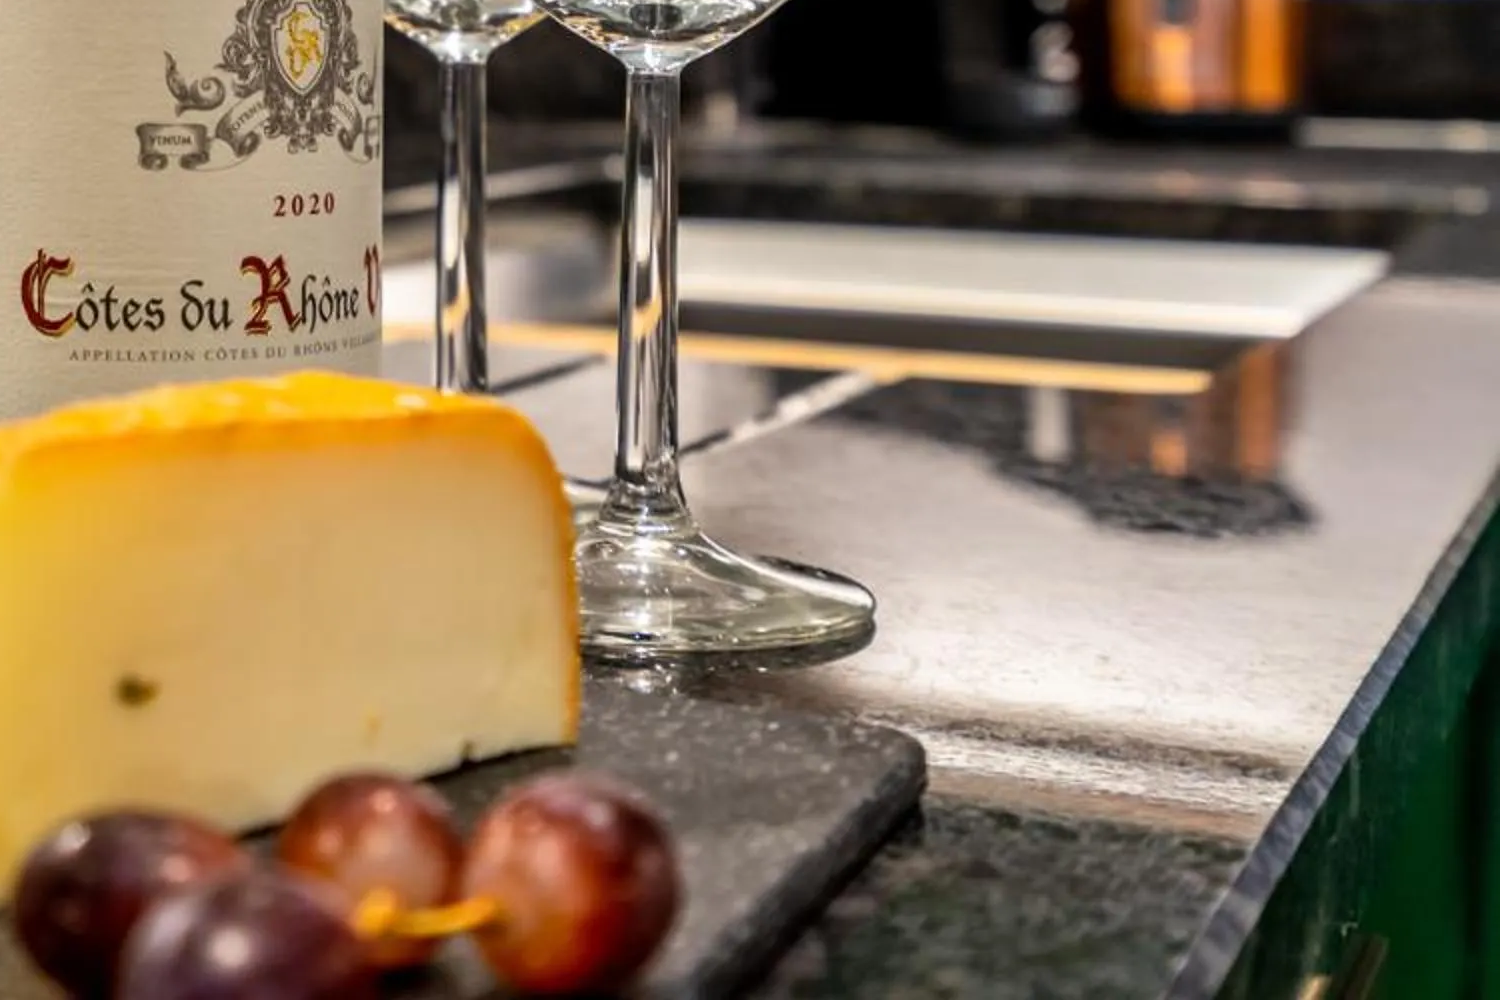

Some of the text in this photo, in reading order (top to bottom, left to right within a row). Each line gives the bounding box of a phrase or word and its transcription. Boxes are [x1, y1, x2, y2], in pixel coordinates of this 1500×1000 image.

[273, 193, 335, 217] 2020
[21, 248, 165, 336] Côtes
[180, 279, 233, 331] du
[240, 254, 359, 335] Rhône
[69, 348, 196, 362] APPELLATION
